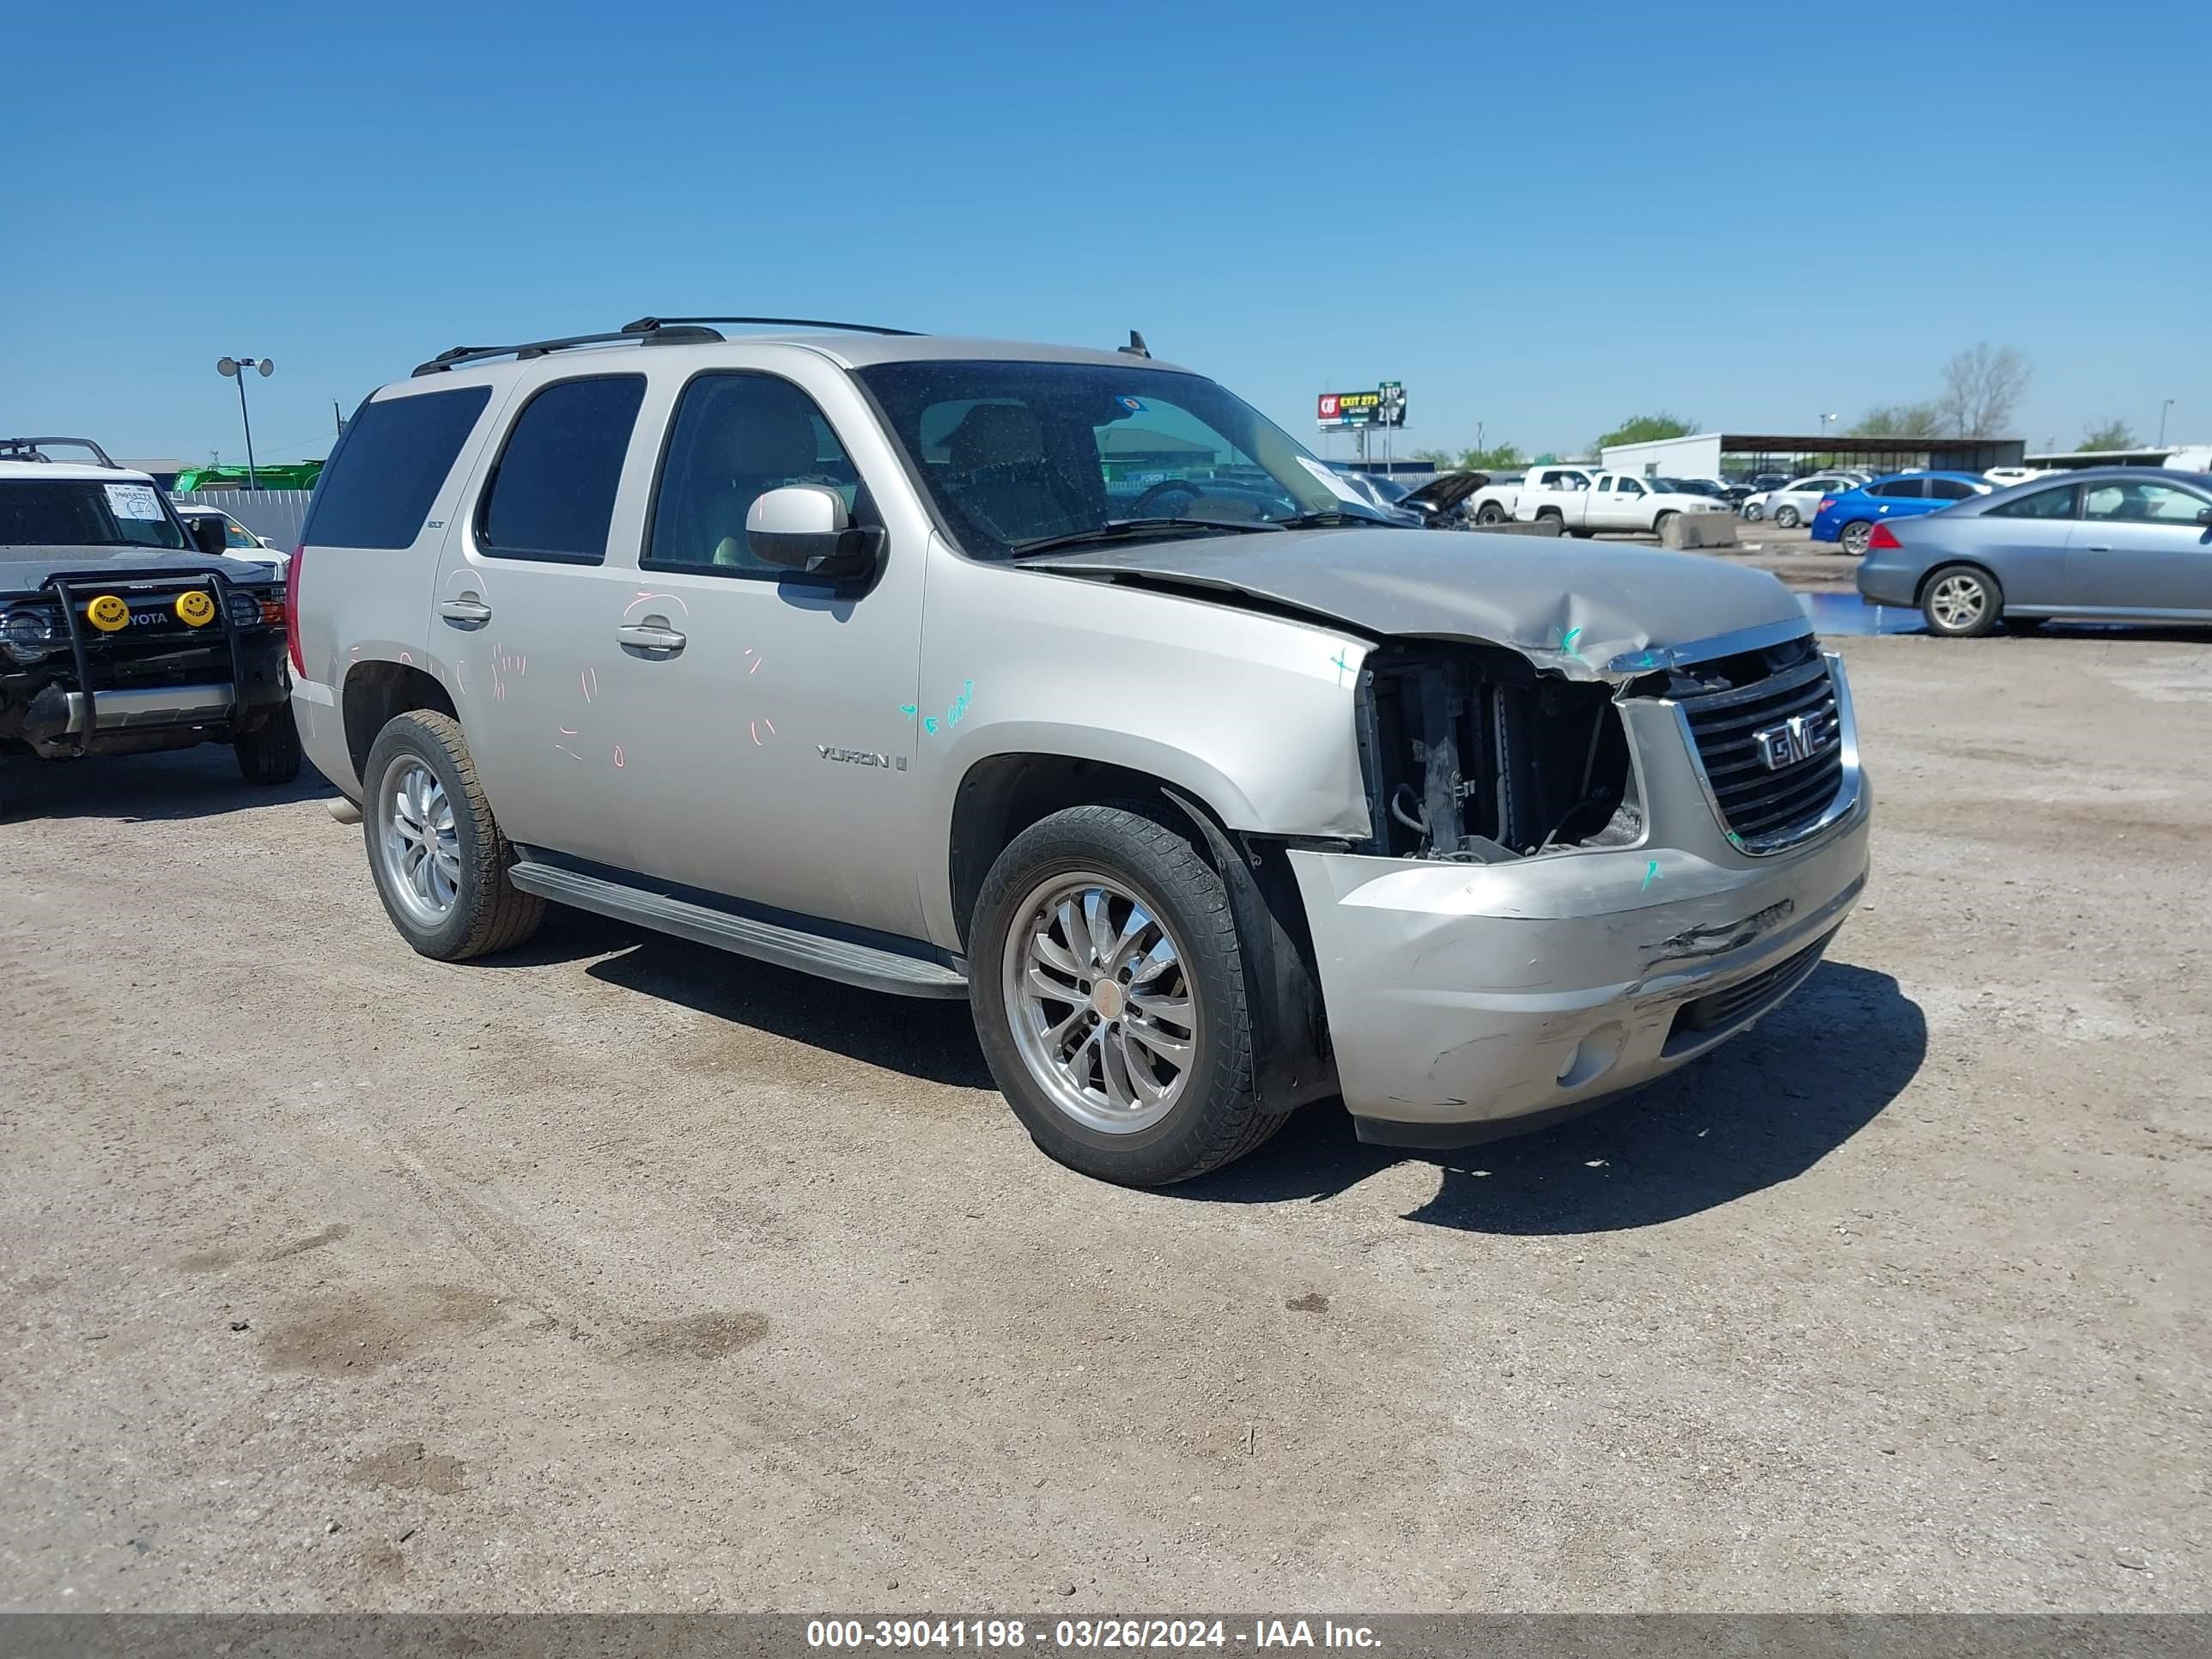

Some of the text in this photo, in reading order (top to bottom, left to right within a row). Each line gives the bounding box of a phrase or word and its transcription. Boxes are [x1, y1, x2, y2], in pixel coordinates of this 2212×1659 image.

[1340, 395, 1379, 407] EXIT 273
[1759, 710, 1827, 770] GMC
[815, 744, 890, 769] YUKON
